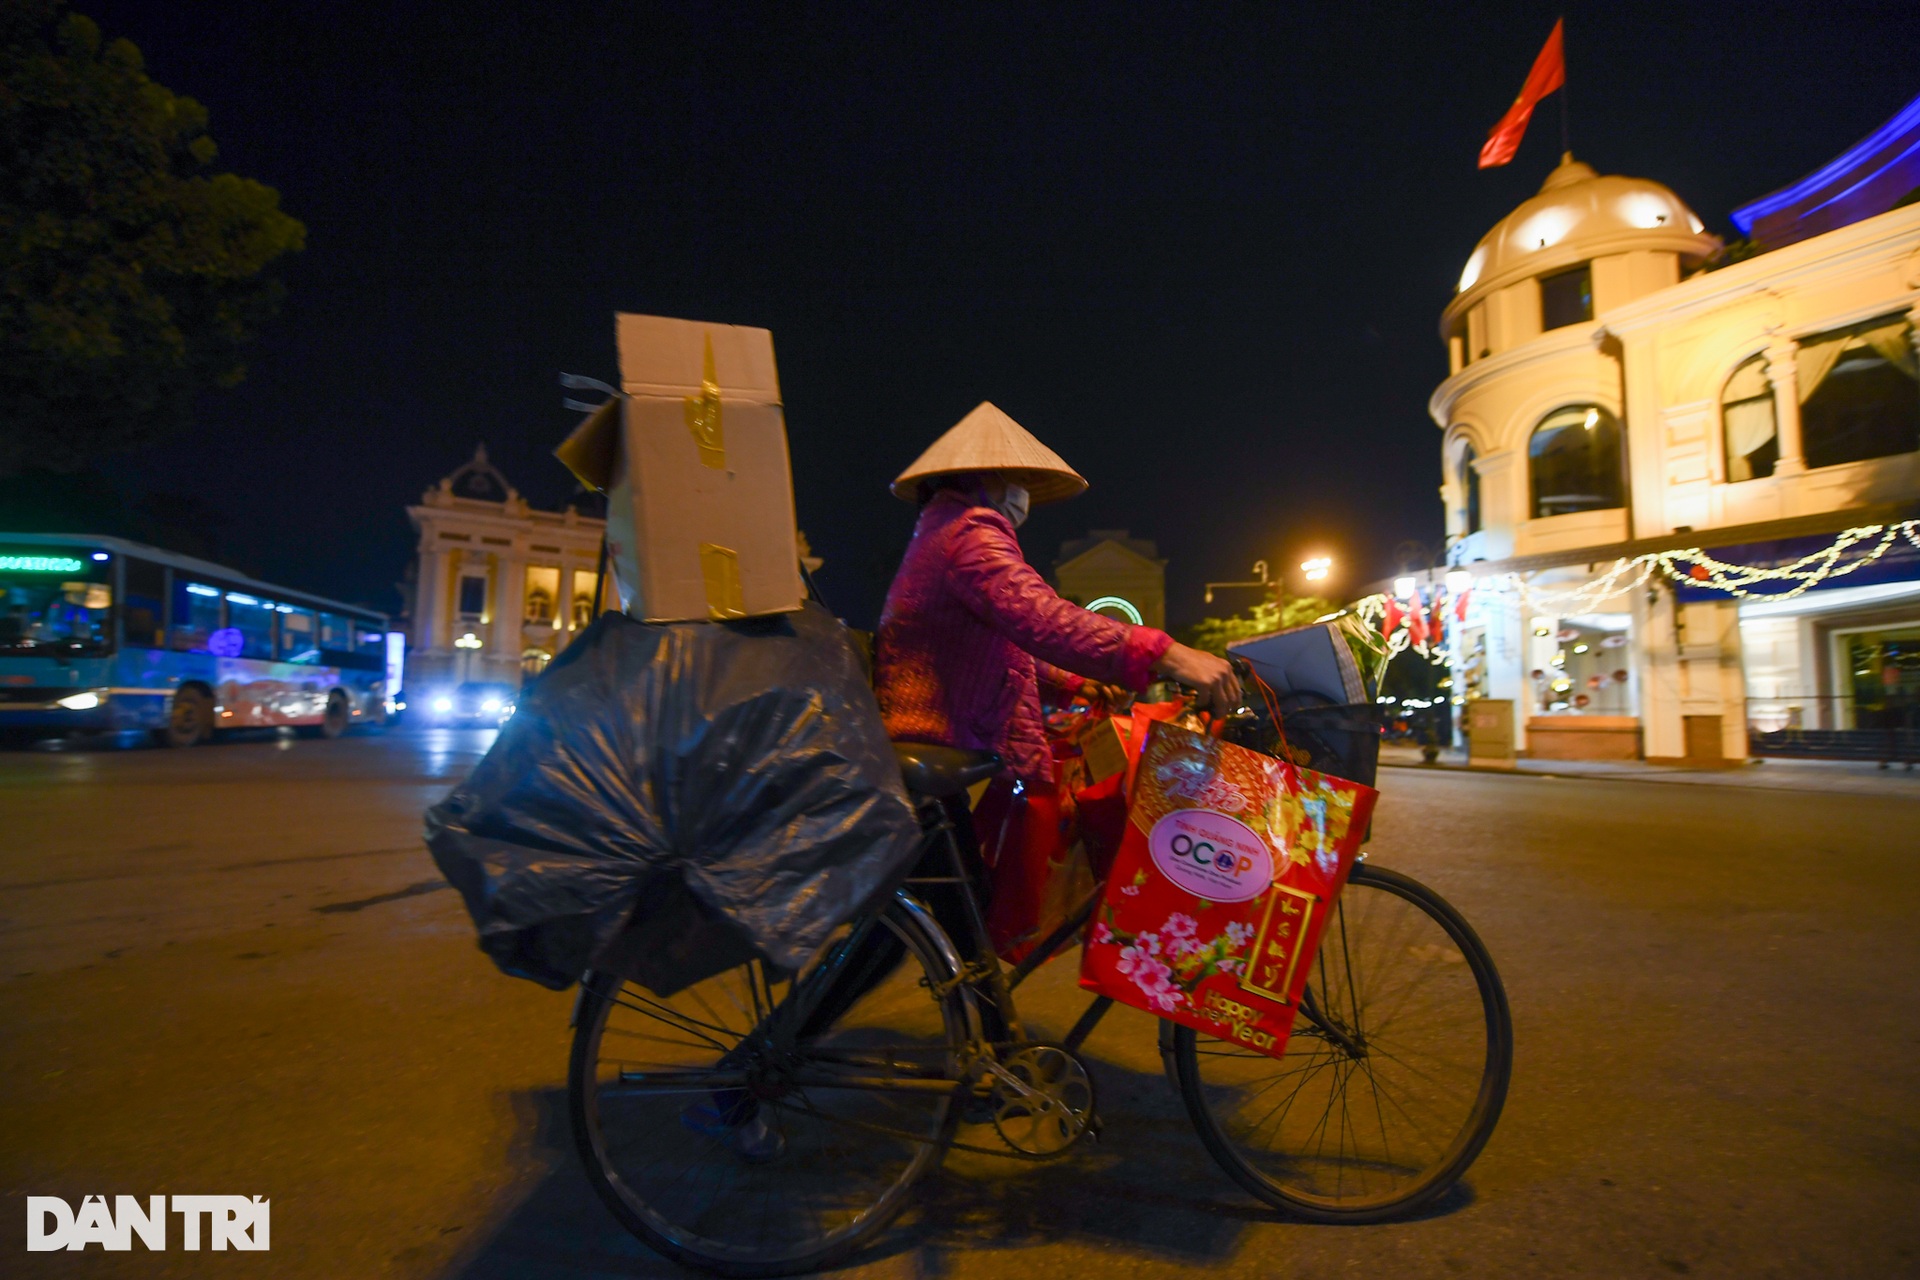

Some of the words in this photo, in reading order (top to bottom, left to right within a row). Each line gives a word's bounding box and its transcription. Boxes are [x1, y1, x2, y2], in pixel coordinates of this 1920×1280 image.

[1171, 834, 1253, 878] OCOP
[1205, 988, 1264, 1022] Happy
[1230, 1018, 1278, 1050] Year
